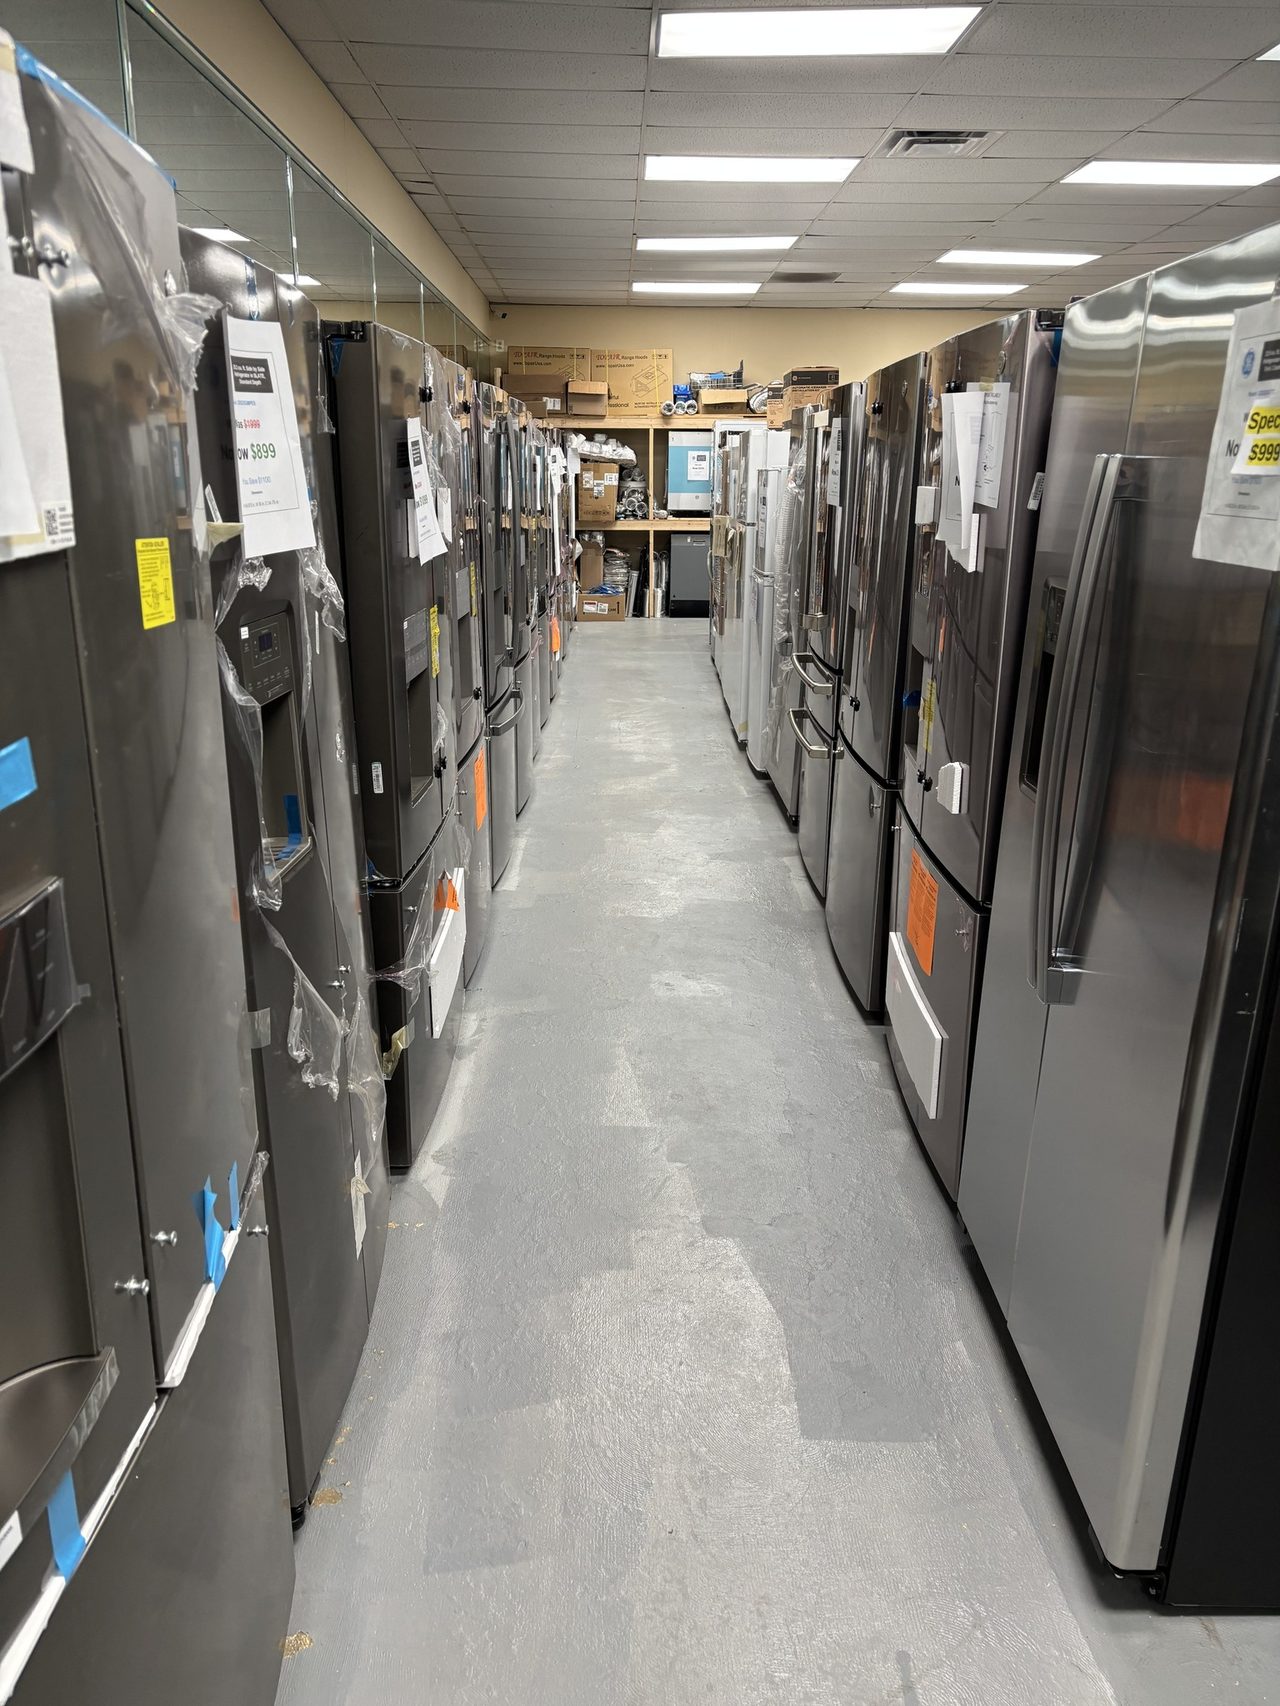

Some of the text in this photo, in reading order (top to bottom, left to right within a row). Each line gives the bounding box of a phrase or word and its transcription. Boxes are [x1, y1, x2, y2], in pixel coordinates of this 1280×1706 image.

[1248, 411, 1280, 434] Spec
[250, 442, 276, 461] $899
[1225, 439, 1240, 457] No
